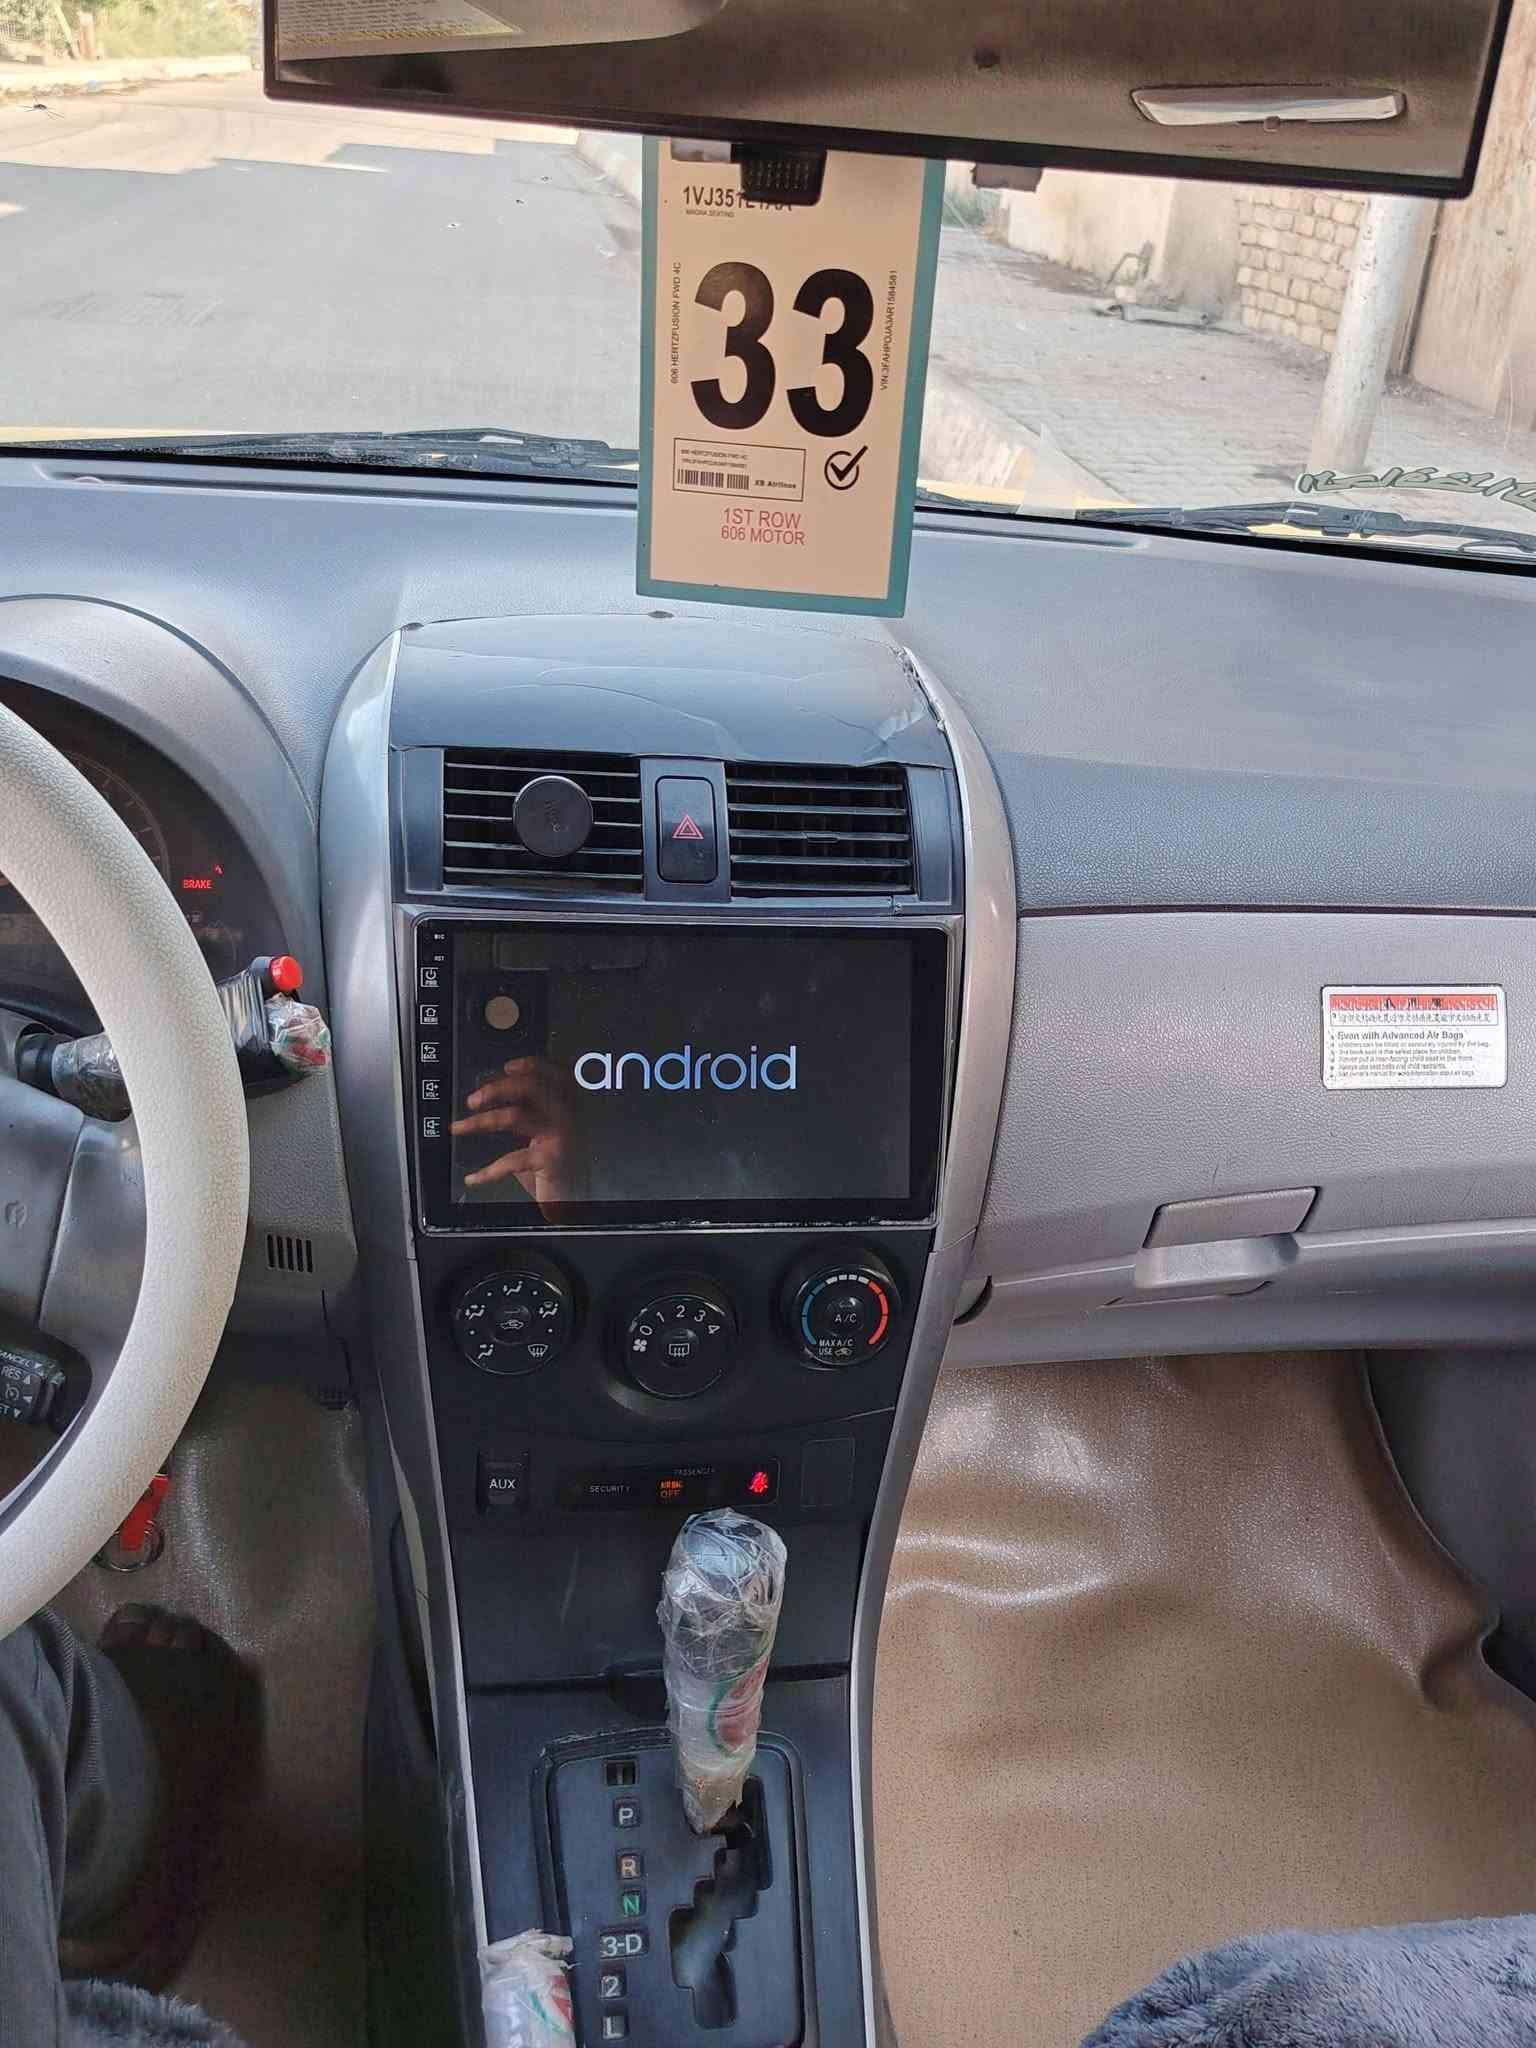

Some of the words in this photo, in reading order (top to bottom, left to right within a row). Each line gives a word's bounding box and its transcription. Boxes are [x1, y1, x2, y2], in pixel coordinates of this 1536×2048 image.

[683, 185, 792, 211] 1VJ351
[691, 262, 874, 437] 33
[724, 507, 754, 526] 1ST
[759, 510, 801, 529] ROW
[721, 525, 746, 541] 606
[751, 527, 805, 546] MOTOR
[183, 879, 213, 889] BRAKE
[574, 1045, 797, 1090] android
[656, 1311, 665, 1322] 1
[676, 1304, 686, 1318] 2
[694, 1309, 707, 1322] 3
[708, 1324, 721, 1335] 4
[834, 1312, 857, 1324] A/C
[819, 1339, 835, 1347] MAX
[489, 1478, 516, 1489] AUX
[590, 1485, 632, 1493] SECURITY
[618, 1807, 634, 1825] P
[622, 1857, 639, 1879] R
[623, 1894, 641, 1915] N
[601, 1933, 642, 1957] 3-D
[602, 1975, 621, 1997] 2
[604, 2015, 624, 2040] L
